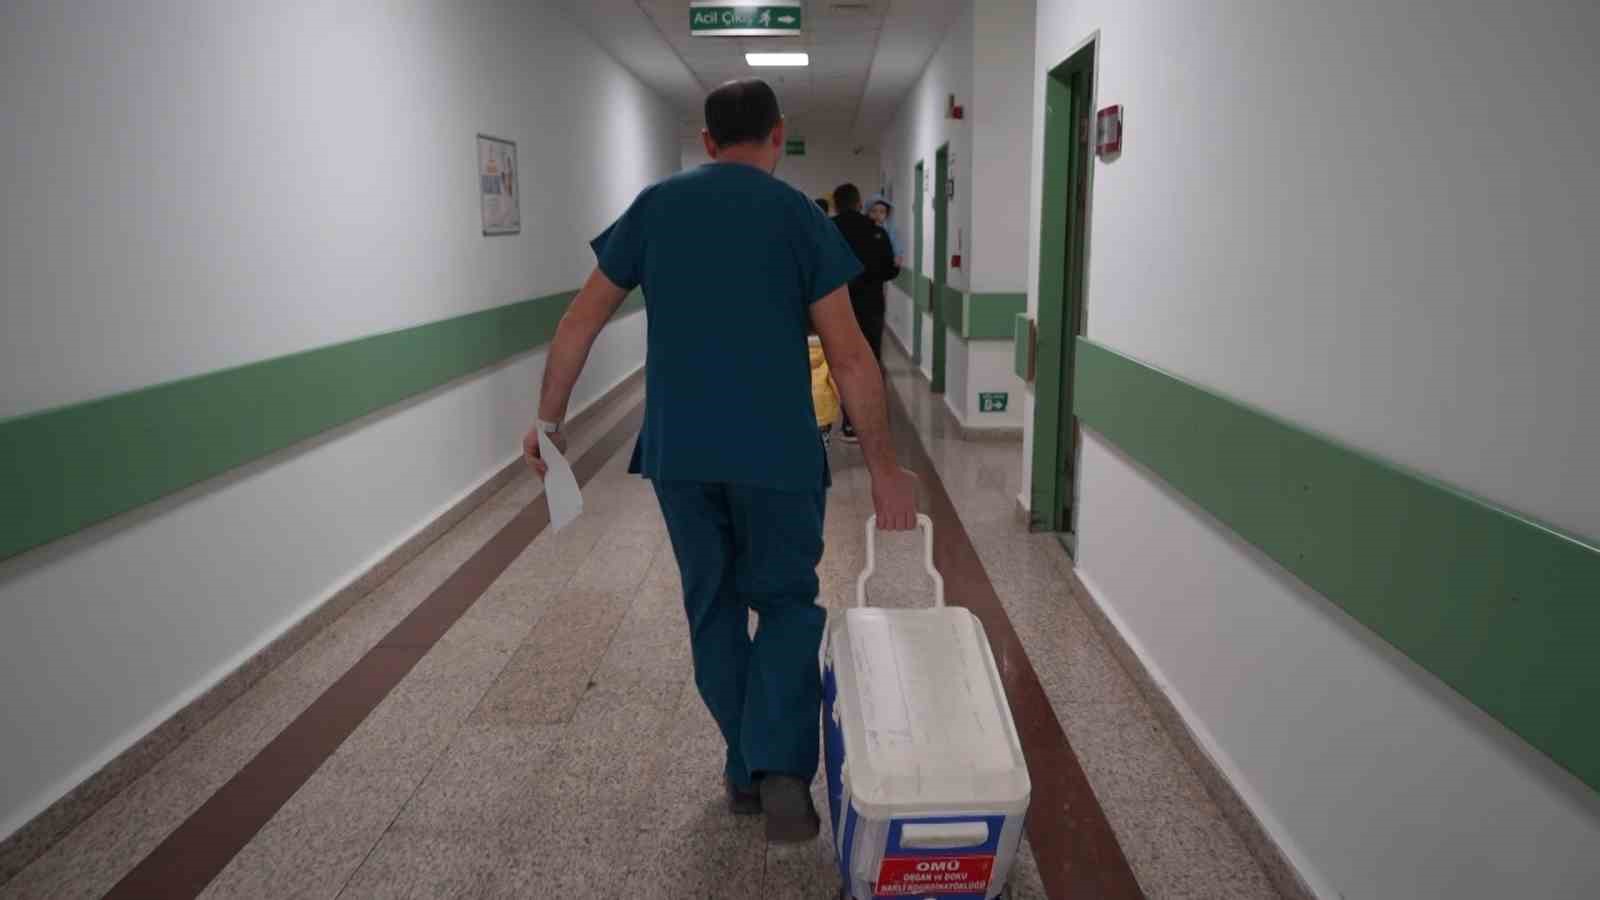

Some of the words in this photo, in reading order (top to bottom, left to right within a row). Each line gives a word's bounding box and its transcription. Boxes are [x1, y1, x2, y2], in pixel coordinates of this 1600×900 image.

[694, 11, 718, 25] Acil
[916, 859, 960, 871] OMÜ
[903, 872, 932, 881] ORGAN
